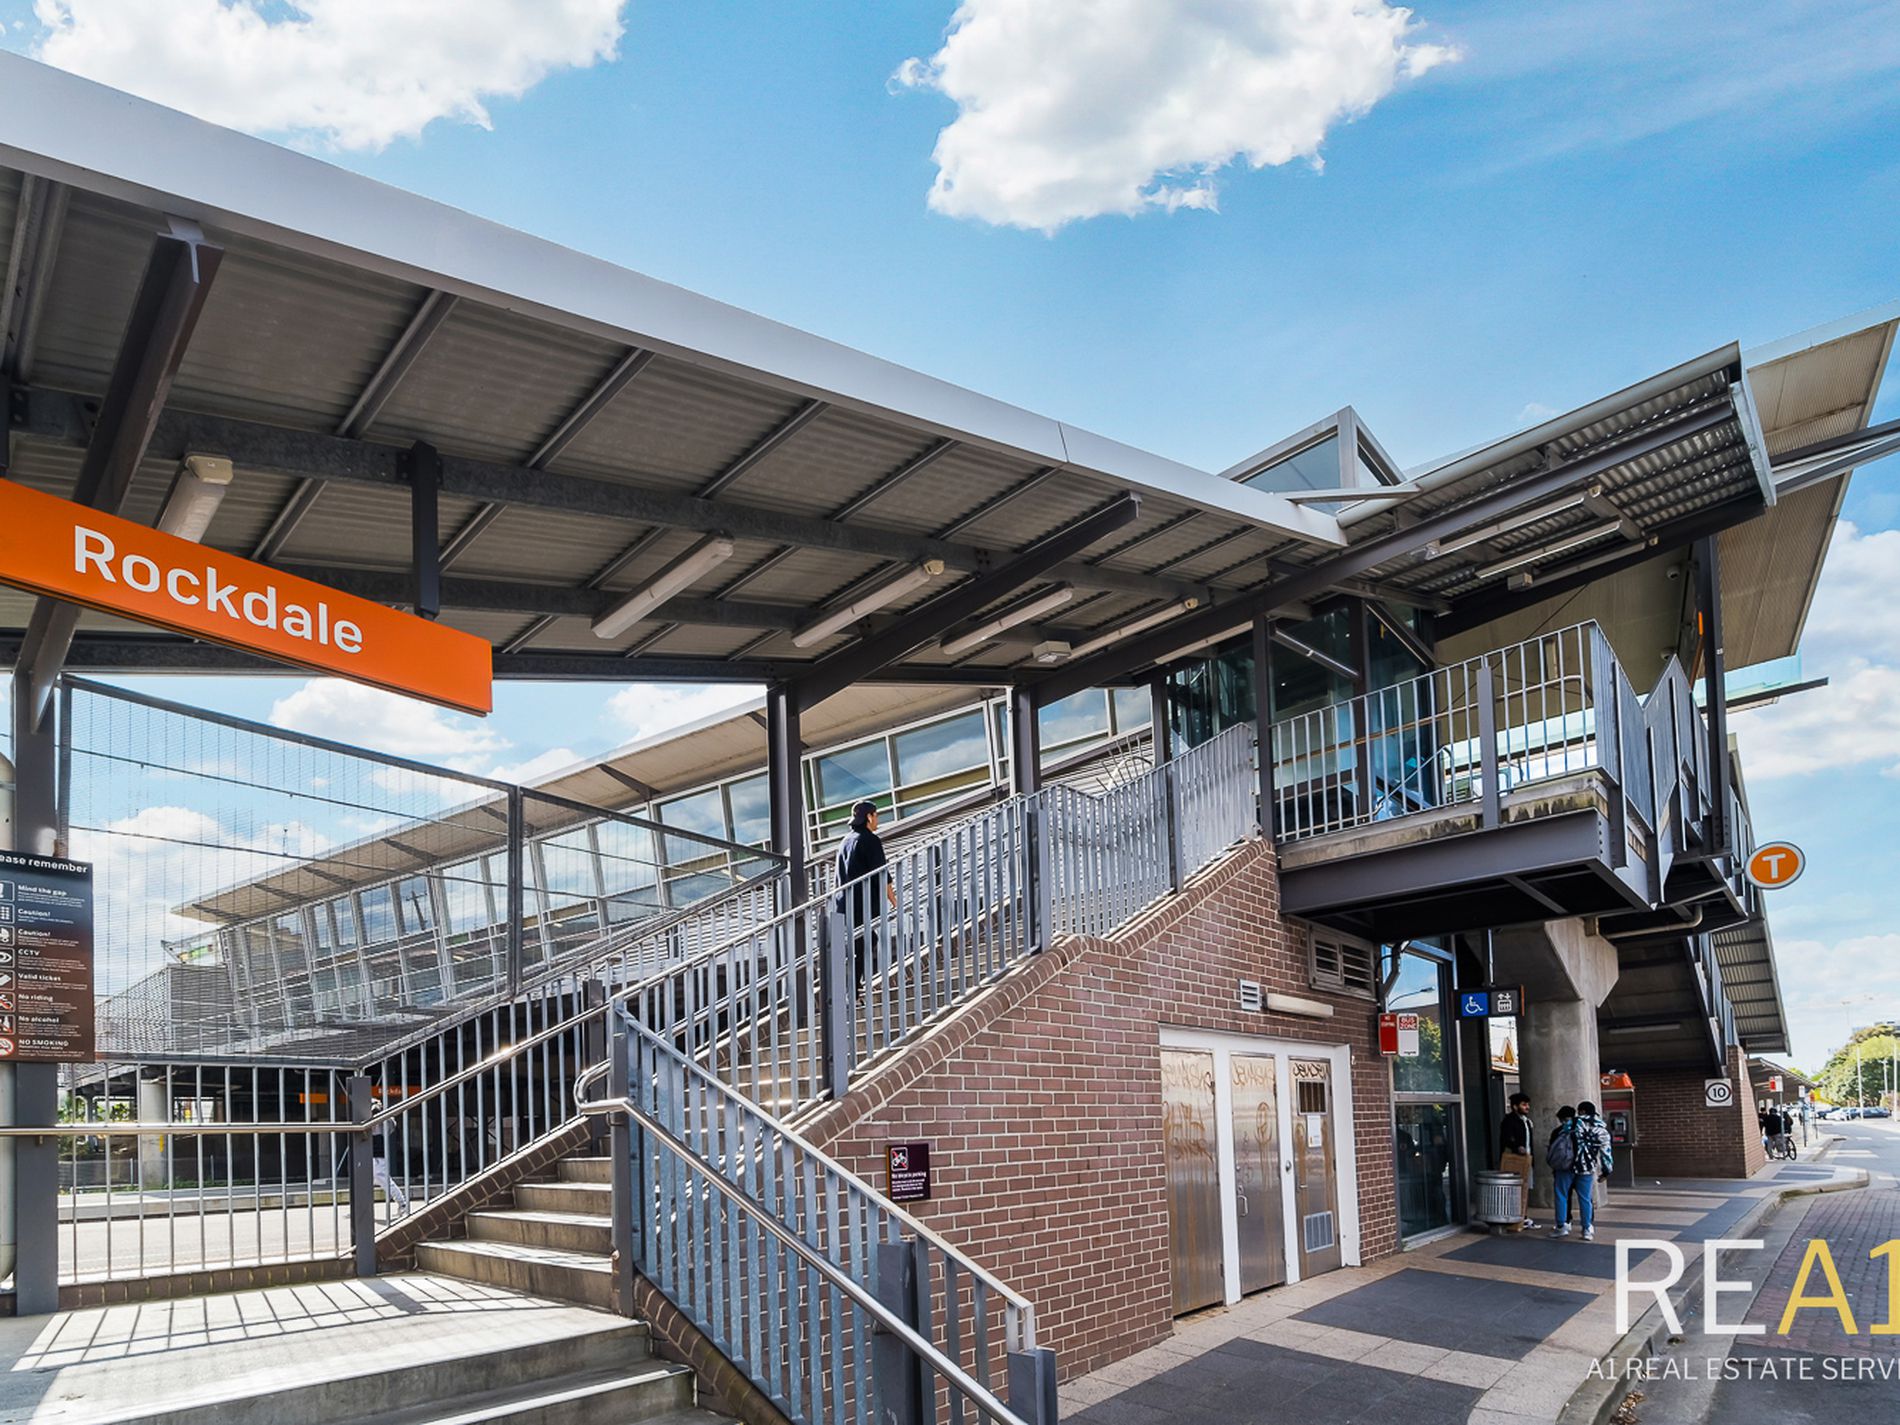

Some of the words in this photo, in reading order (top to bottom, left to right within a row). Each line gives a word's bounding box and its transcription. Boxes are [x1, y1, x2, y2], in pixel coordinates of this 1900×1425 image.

[73, 524, 364, 655] Rockdale
[28, 858, 88, 873] remember
[1762, 853, 1787, 880] T
[18, 884, 37, 893] Mind
[18, 908, 51, 917] Caution!
[18, 928, 51, 937] Caution!
[18, 948, 40, 956] CCTV
[18, 972, 37, 980] Valid
[39, 974, 62, 982] ticket
[32, 1039, 69, 1047] SMOKING
[1713, 1087, 1726, 1098] 10
